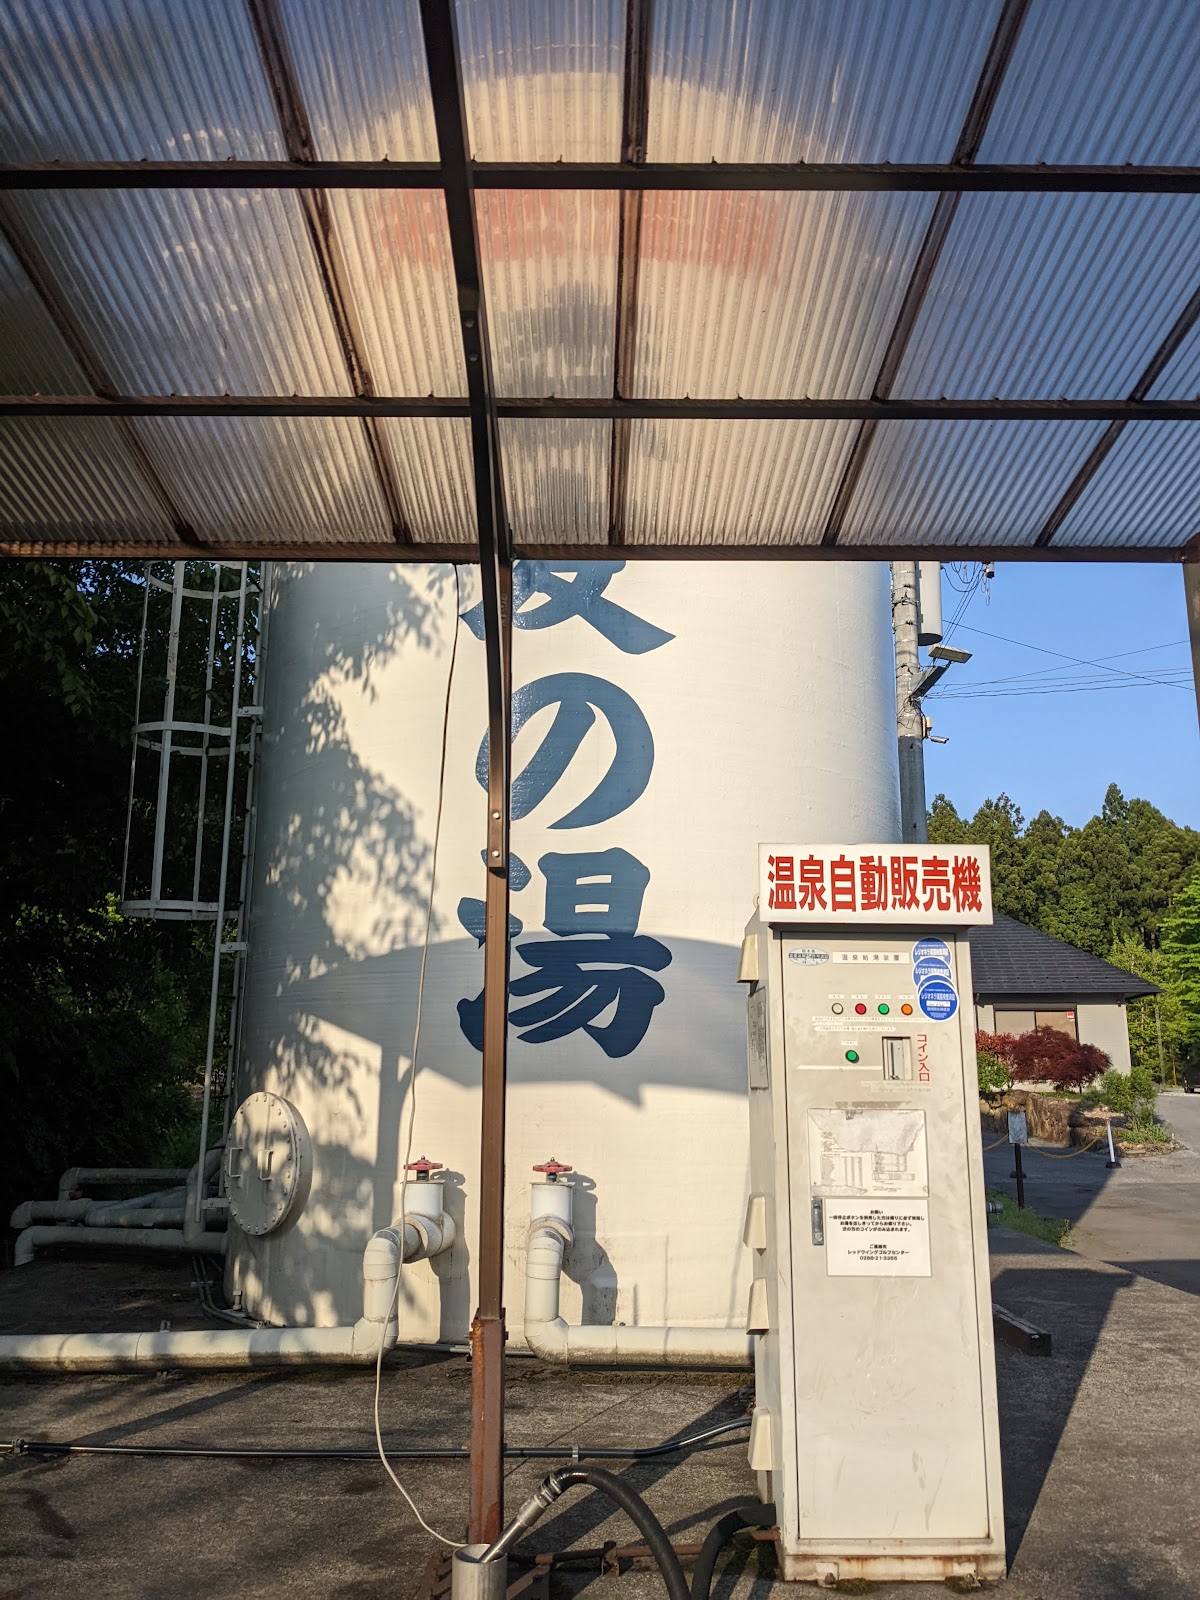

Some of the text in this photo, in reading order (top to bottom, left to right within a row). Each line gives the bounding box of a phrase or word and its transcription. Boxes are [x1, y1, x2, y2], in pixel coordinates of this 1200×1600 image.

[767, 854, 983, 913] 温泉自動販売機
[917, 1034, 930, 1082] コイン入口
